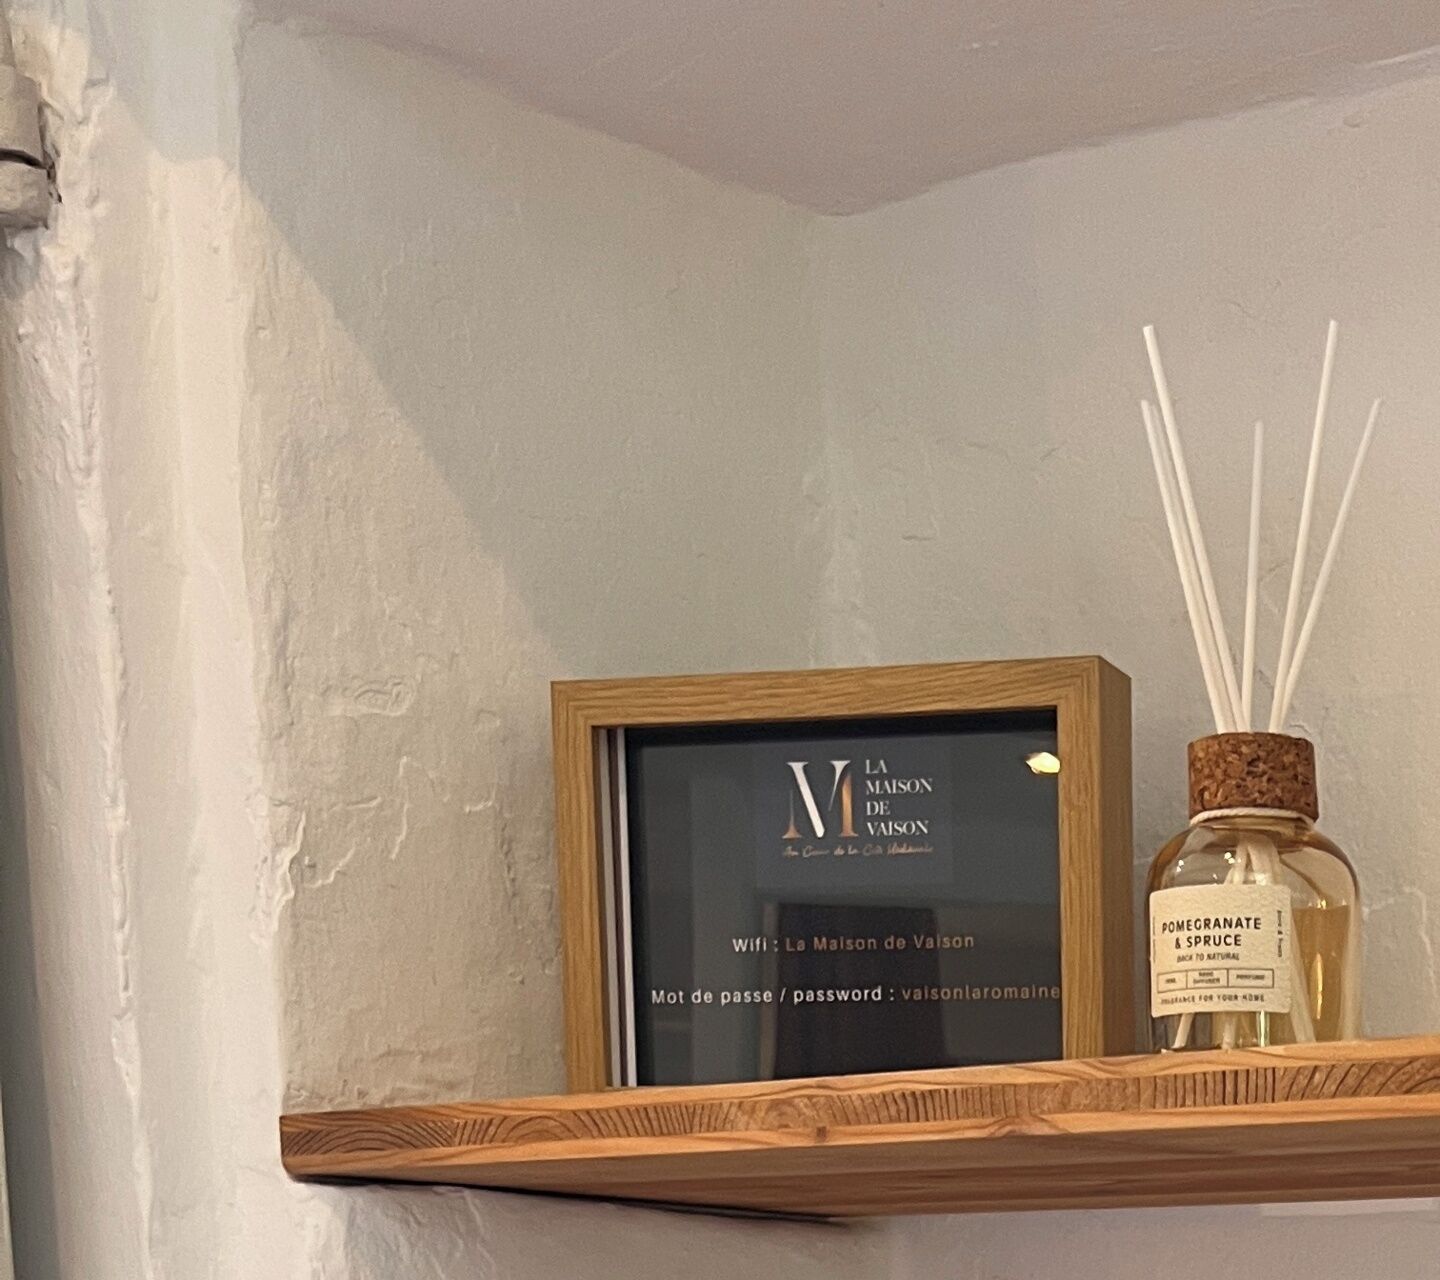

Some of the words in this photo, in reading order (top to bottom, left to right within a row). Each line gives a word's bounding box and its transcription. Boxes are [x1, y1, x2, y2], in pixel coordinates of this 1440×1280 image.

[865, 759, 888, 774] LA
[865, 778, 933, 795] MAISON
[866, 800, 891, 815] DE
[866, 820, 929, 836] VAISON
[1161, 916, 1262, 934] POMEGRANATE
[732, 936, 768, 953] Wifi
[785, 937, 806, 952] La
[813, 936, 877, 951] Maison
[884, 935, 906, 950] de
[913, 934, 974, 949] Vaison
[1186, 934, 1242, 949] SPRUCE
[1196, 952, 1205, 962] TO
[1207, 952, 1240, 962] NATURAL
[651, 989, 684, 1005] Mot
[691, 988, 713, 1004] de
[721, 989, 773, 1007] passe
[793, 986, 882, 1006] password
[902, 984, 1060, 1000] vaisonlaromaine
[1199, 994, 1213, 1002] FOR
[1216, 994, 1239, 1002] YOUR
[1242, 993, 1265, 1003] HOME
